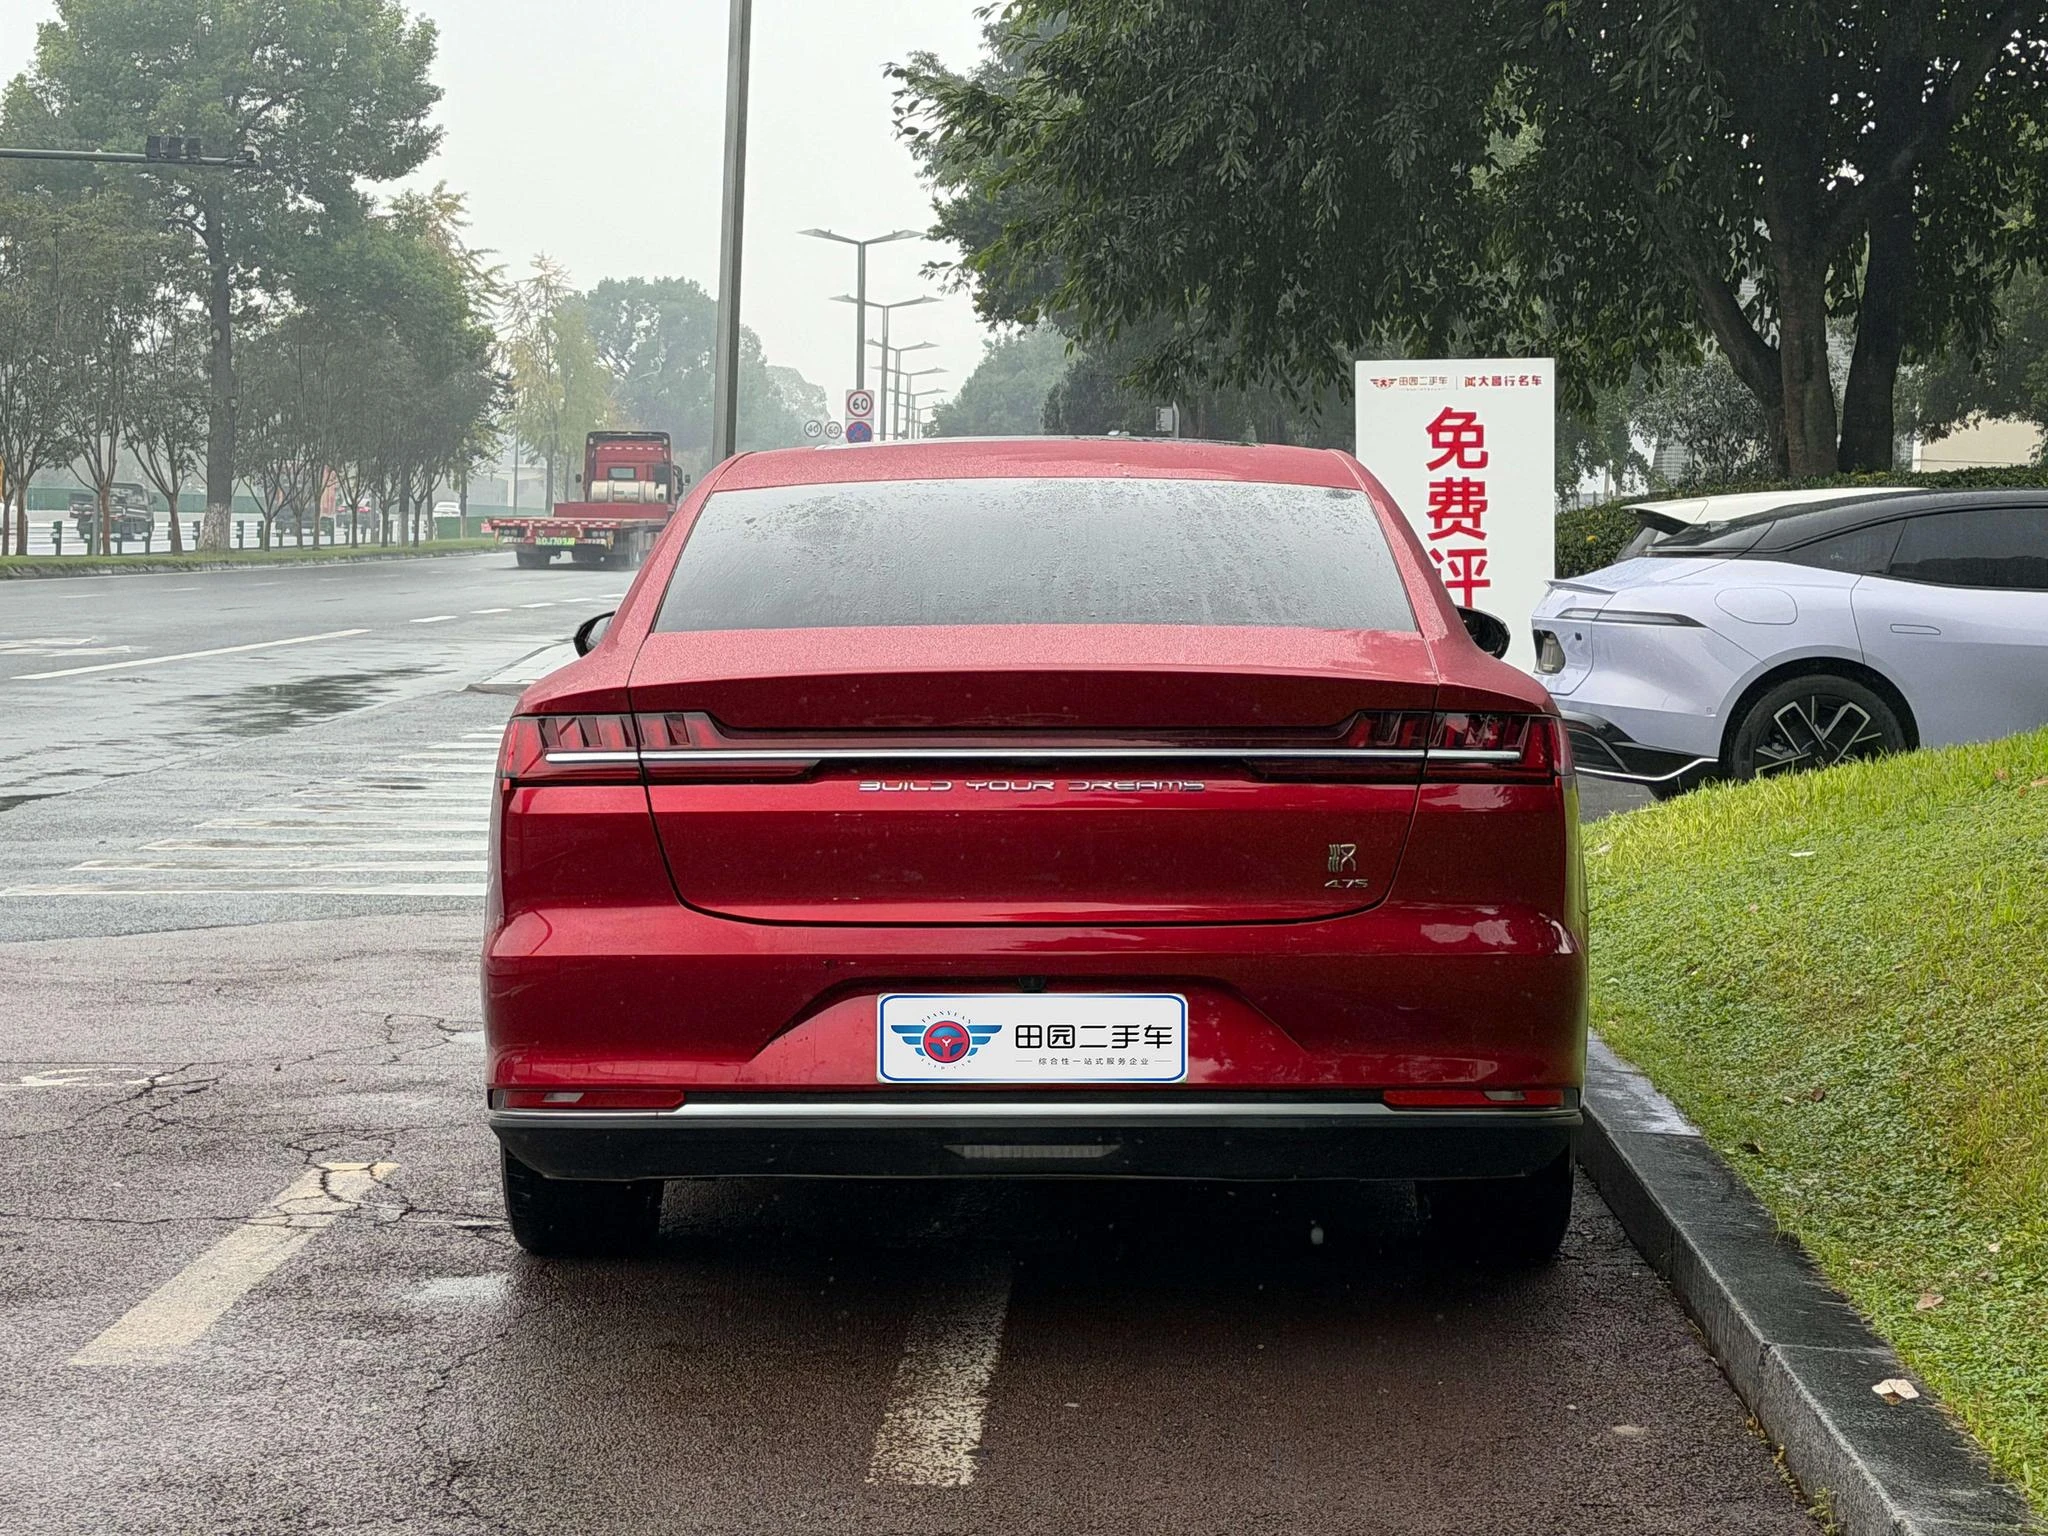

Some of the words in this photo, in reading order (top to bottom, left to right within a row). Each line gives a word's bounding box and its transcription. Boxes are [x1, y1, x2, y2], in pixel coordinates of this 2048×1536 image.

[853, 398, 868, 410] 60
[828, 426, 839, 435] 60
[1425, 406, 1491, 608] 免费评
[859, 780, 953, 791] BUILD
[966, 780, 1055, 791] YOUR
[1068, 780, 1205, 791] DREAMS
[1015, 1024, 1173, 1049] 田园二手车
[1038, 1057, 1149, 1066] 综合性一站式服务企业
